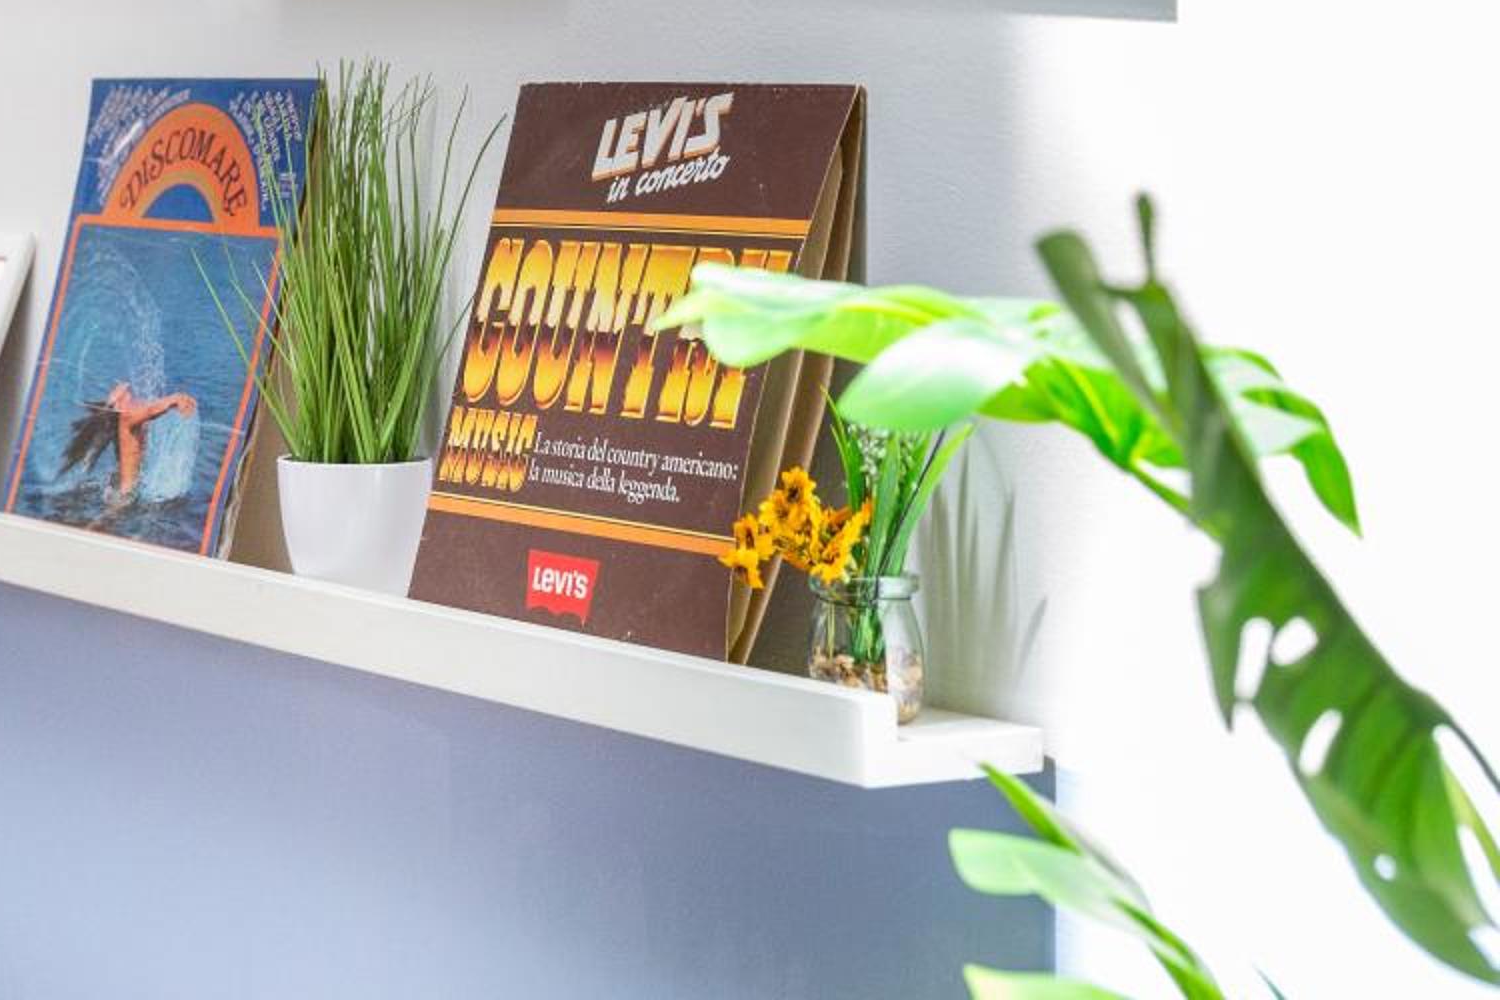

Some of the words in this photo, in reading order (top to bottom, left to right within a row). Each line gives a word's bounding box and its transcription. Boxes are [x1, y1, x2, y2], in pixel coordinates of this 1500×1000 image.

[120, 128, 247, 216] DISCOMARE
[592, 92, 734, 181] LEVI'S
[606, 176, 630, 203] in
[635, 146, 730, 195] concerto
[439, 406, 538, 492] MUSIC
[528, 456, 539, 481] la
[541, 464, 583, 488] musica
[586, 464, 615, 493] della
[617, 470, 680, 504] leggenda.
[534, 432, 550, 454] La
[550, 436, 586, 459] storia
[586, 437, 607, 462] del
[607, 448, 660, 476] country
[661, 451, 738, 480] americano:
